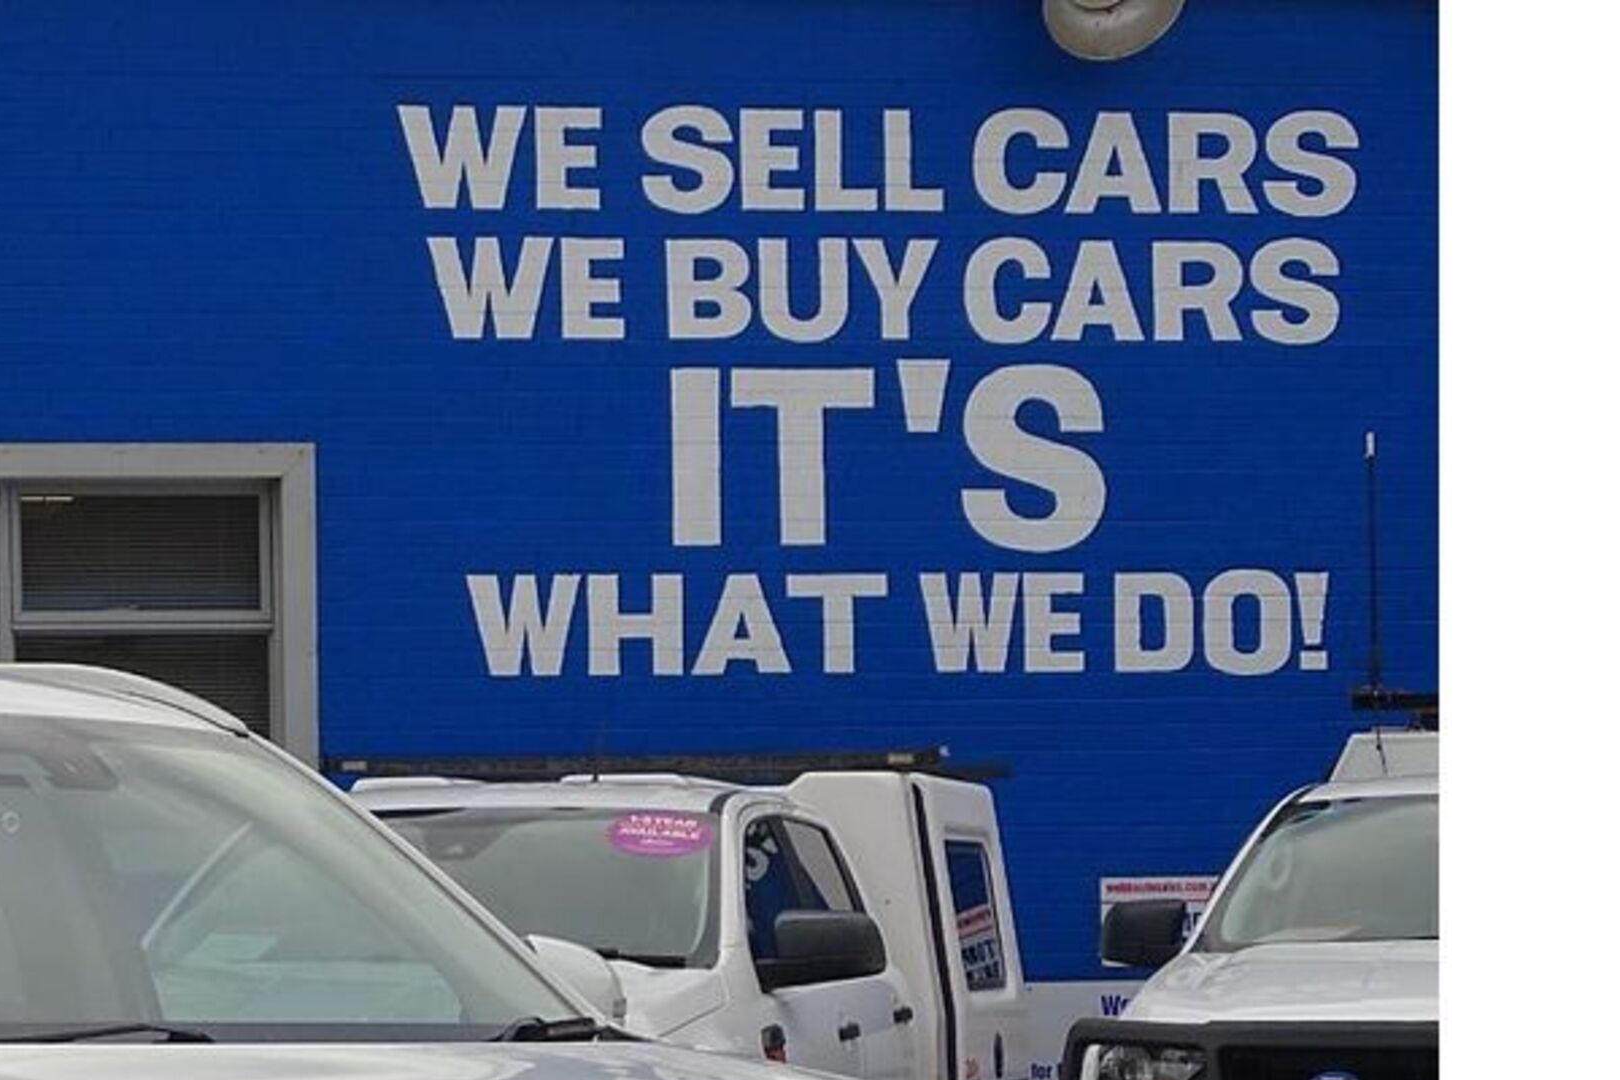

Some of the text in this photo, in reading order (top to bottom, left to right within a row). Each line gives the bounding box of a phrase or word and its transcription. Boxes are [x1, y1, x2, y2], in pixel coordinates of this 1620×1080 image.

[398, 105, 1358, 217] WE SELL CARS
[427, 237, 1339, 345] WE BUY CARS
[671, 360, 1105, 552] IT'S
[467, 570, 1328, 675] WHAT WE DO!
[1030, 1063, 1053, 1080] for
